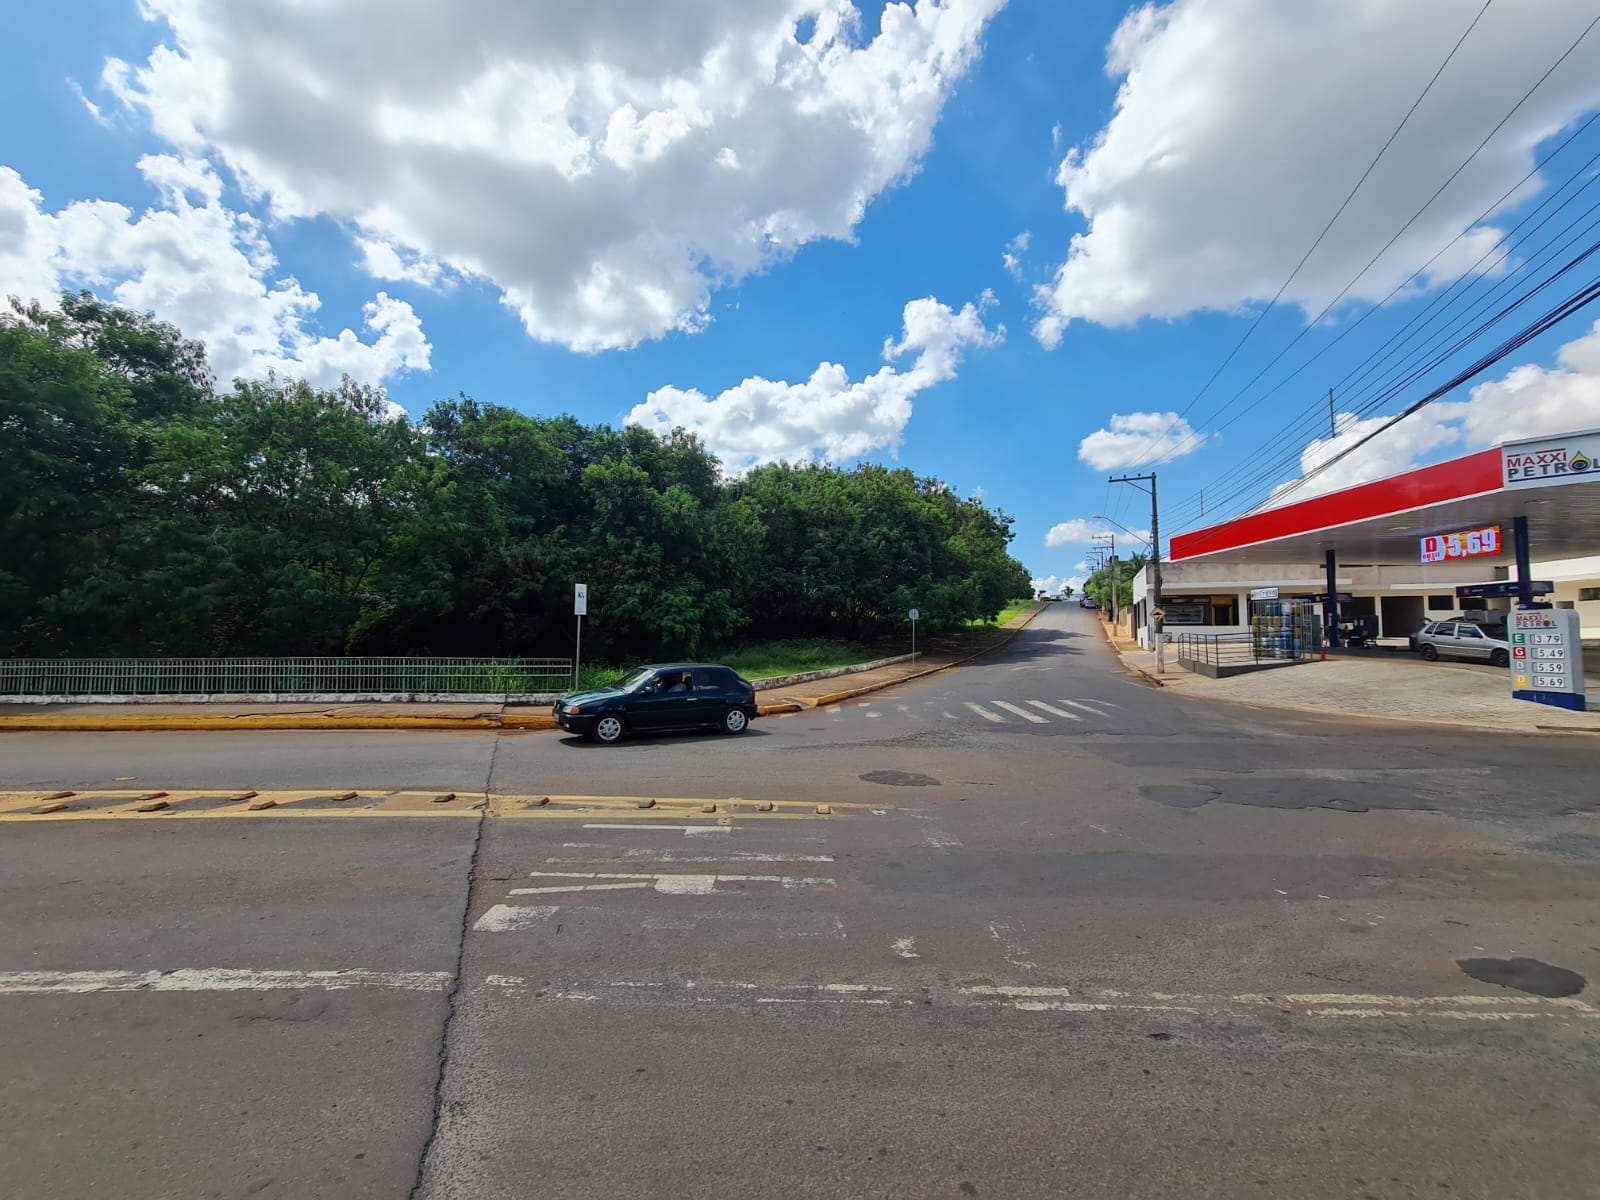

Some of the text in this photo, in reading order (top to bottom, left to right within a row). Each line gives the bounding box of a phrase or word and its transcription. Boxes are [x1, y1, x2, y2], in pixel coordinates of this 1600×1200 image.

[1507, 452, 1567, 468] MAXXI
[1508, 455, 1600, 479] PETROL
[1425, 529, 1496, 557] D 5,69
[1516, 614, 1542, 622] MAXXI
[1516, 618, 1558, 627] PETROL
[1515, 647, 1524, 656] G
[1516, 661, 1524, 669] D
